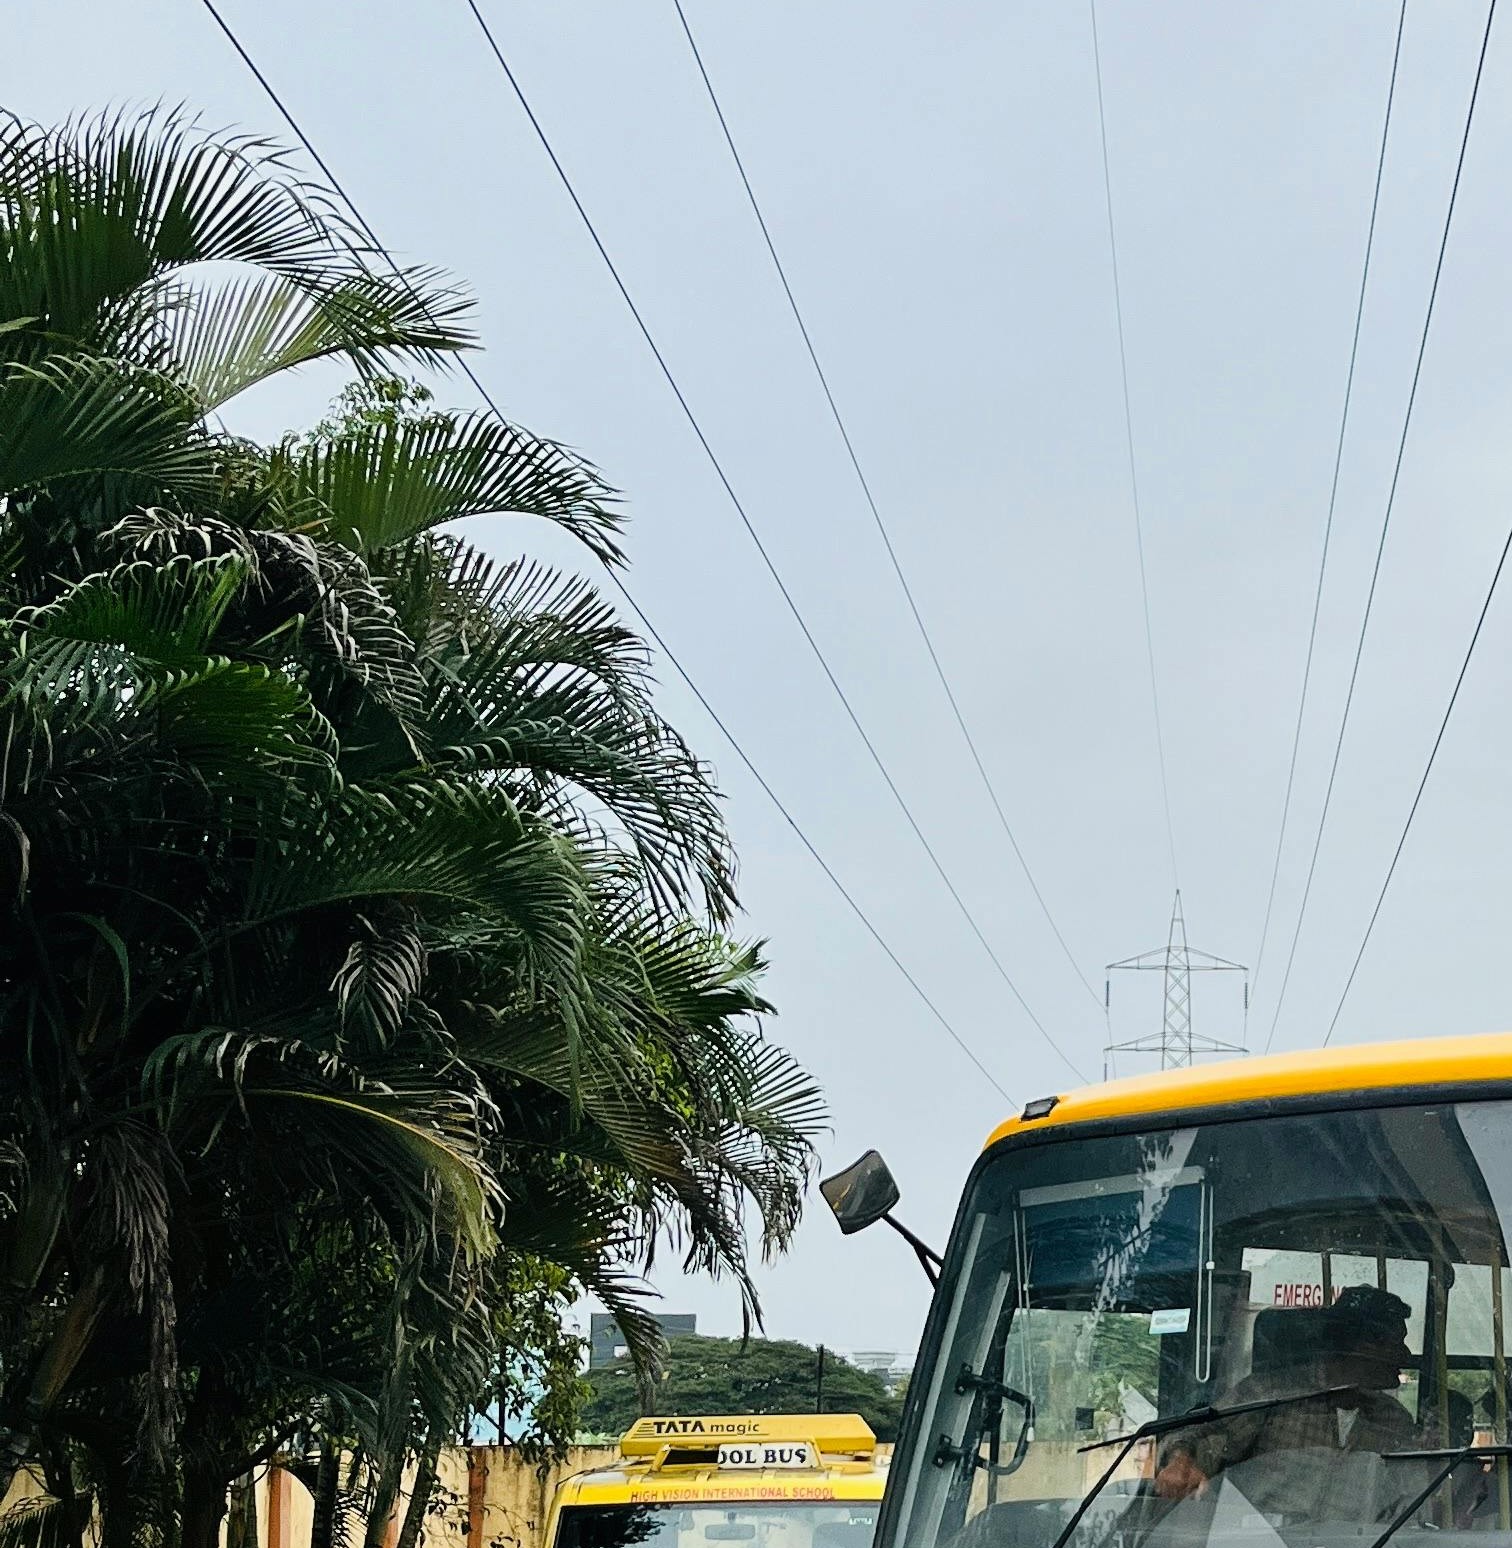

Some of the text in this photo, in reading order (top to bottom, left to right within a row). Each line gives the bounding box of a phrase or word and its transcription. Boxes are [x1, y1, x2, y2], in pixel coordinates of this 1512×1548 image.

[652, 1419, 761, 1436] TATA magic
[762, 1448, 807, 1464] BUS
[631, 1486, 835, 1502] HIGH VISION INTERNATIONAL SCHOOL
